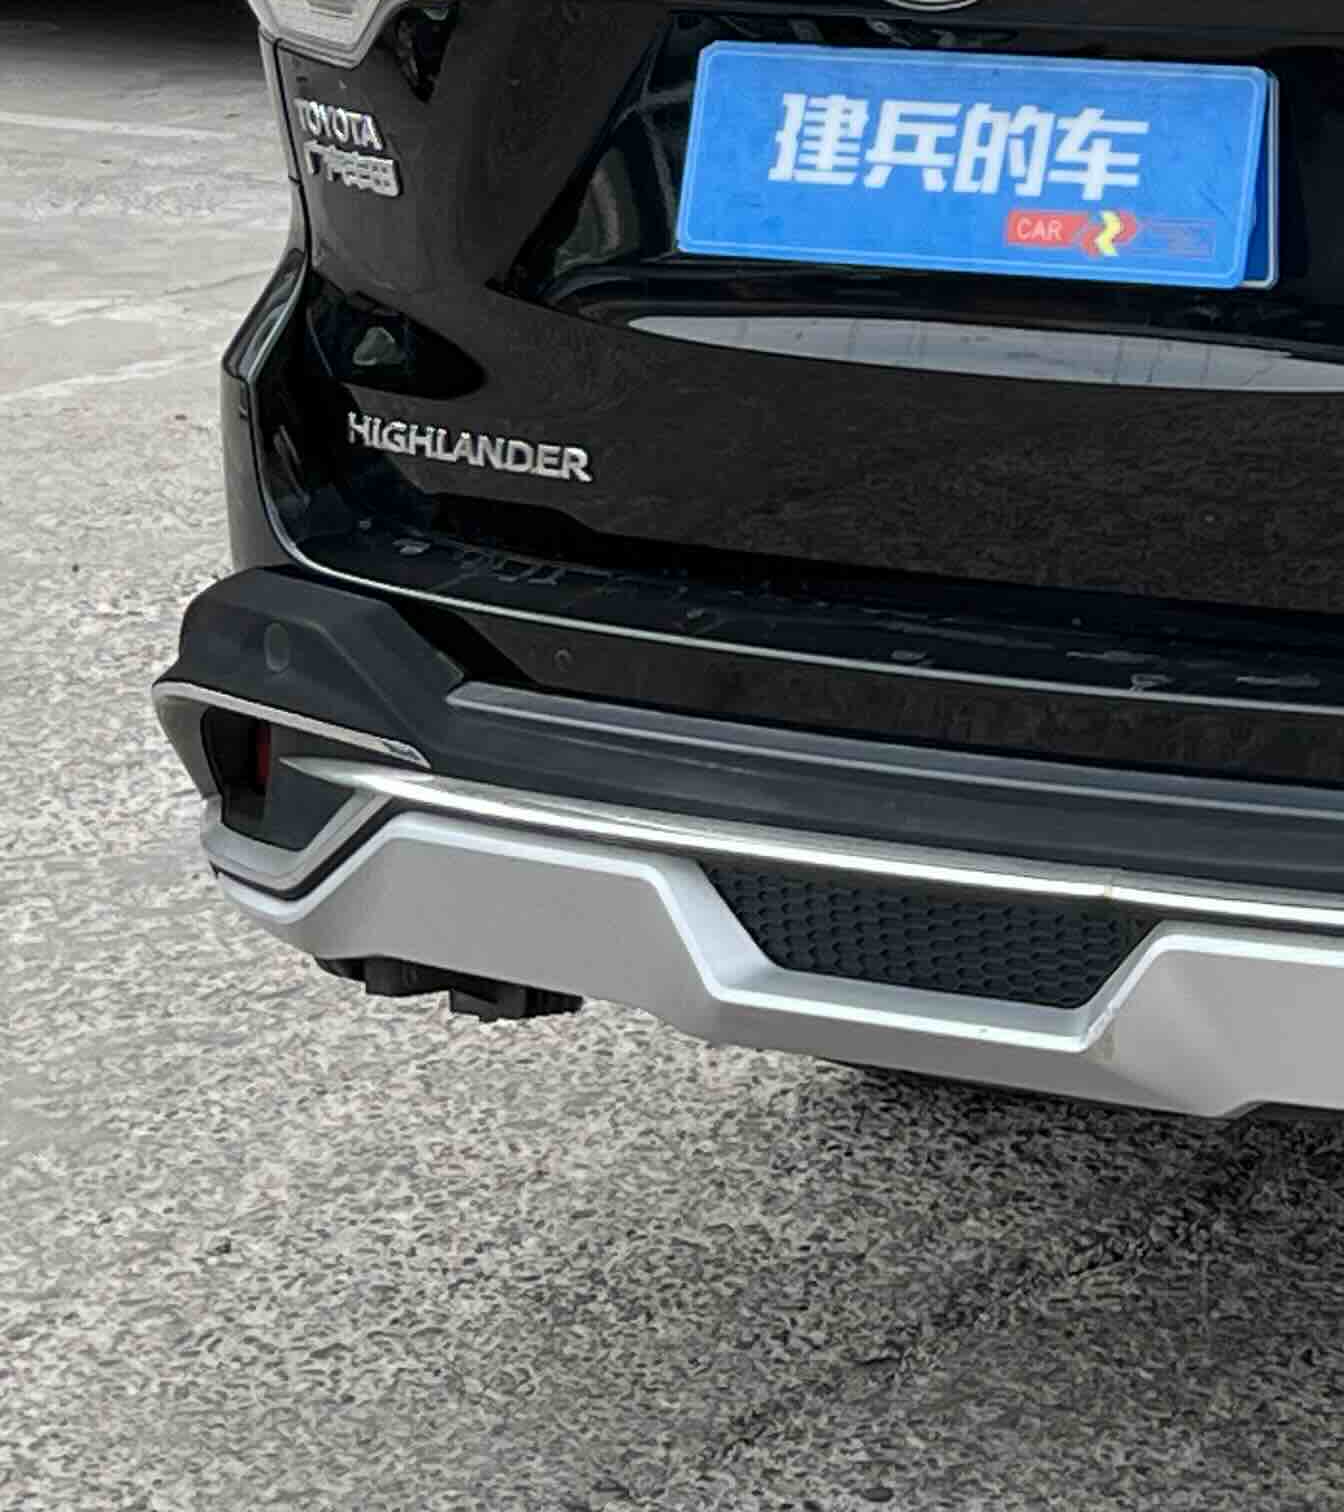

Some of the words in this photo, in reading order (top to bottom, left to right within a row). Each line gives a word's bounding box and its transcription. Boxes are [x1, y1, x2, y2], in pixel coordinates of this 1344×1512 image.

[293, 96, 384, 151] TOYOTA
[768, 91, 1149, 201] 建兵的车
[1016, 217, 1063, 242] CAR
[347, 410, 593, 483] HIGHLANDER
